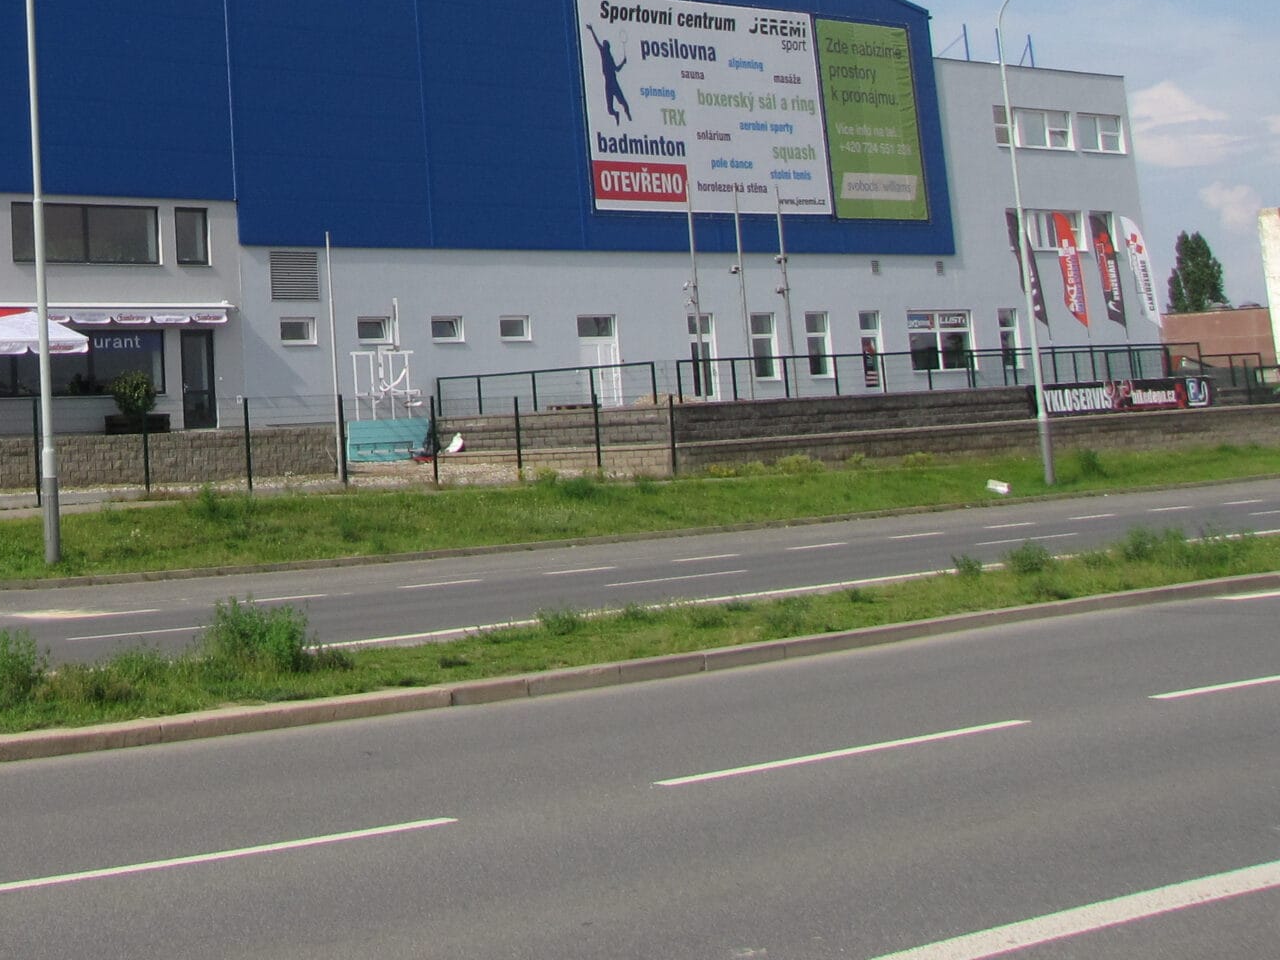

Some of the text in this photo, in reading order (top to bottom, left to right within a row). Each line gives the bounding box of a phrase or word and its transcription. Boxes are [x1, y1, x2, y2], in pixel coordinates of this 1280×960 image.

[600, 0, 737, 32] Sportovní centrum
[640, 38, 716, 62] posilovna
[781, 39, 807, 53] sport
[825, 37, 849, 53] Zde
[680, 69, 705, 81] sauna
[773, 73, 801, 85] masáže
[829, 64, 877, 84] prostory
[640, 86, 676, 101] spinning
[831, 86, 899, 108] k pronájmu.
[697, 88, 816, 116] boxerský sál a ring
[660, 108, 687, 127] TRX
[697, 129, 731, 142] solárium
[770, 121, 794, 135] sporty
[597, 131, 686, 157] badminton
[772, 144, 816, 163] squash
[711, 158, 753, 170] pole dance
[600, 167, 683, 194] OTEVŘENO
[747, 182, 768, 195] stěna
[778, 196, 826, 207] www.jeremi.cz
[94, 335, 141, 349] urant
[1042, 387, 1113, 412] YKLOSERVIS
